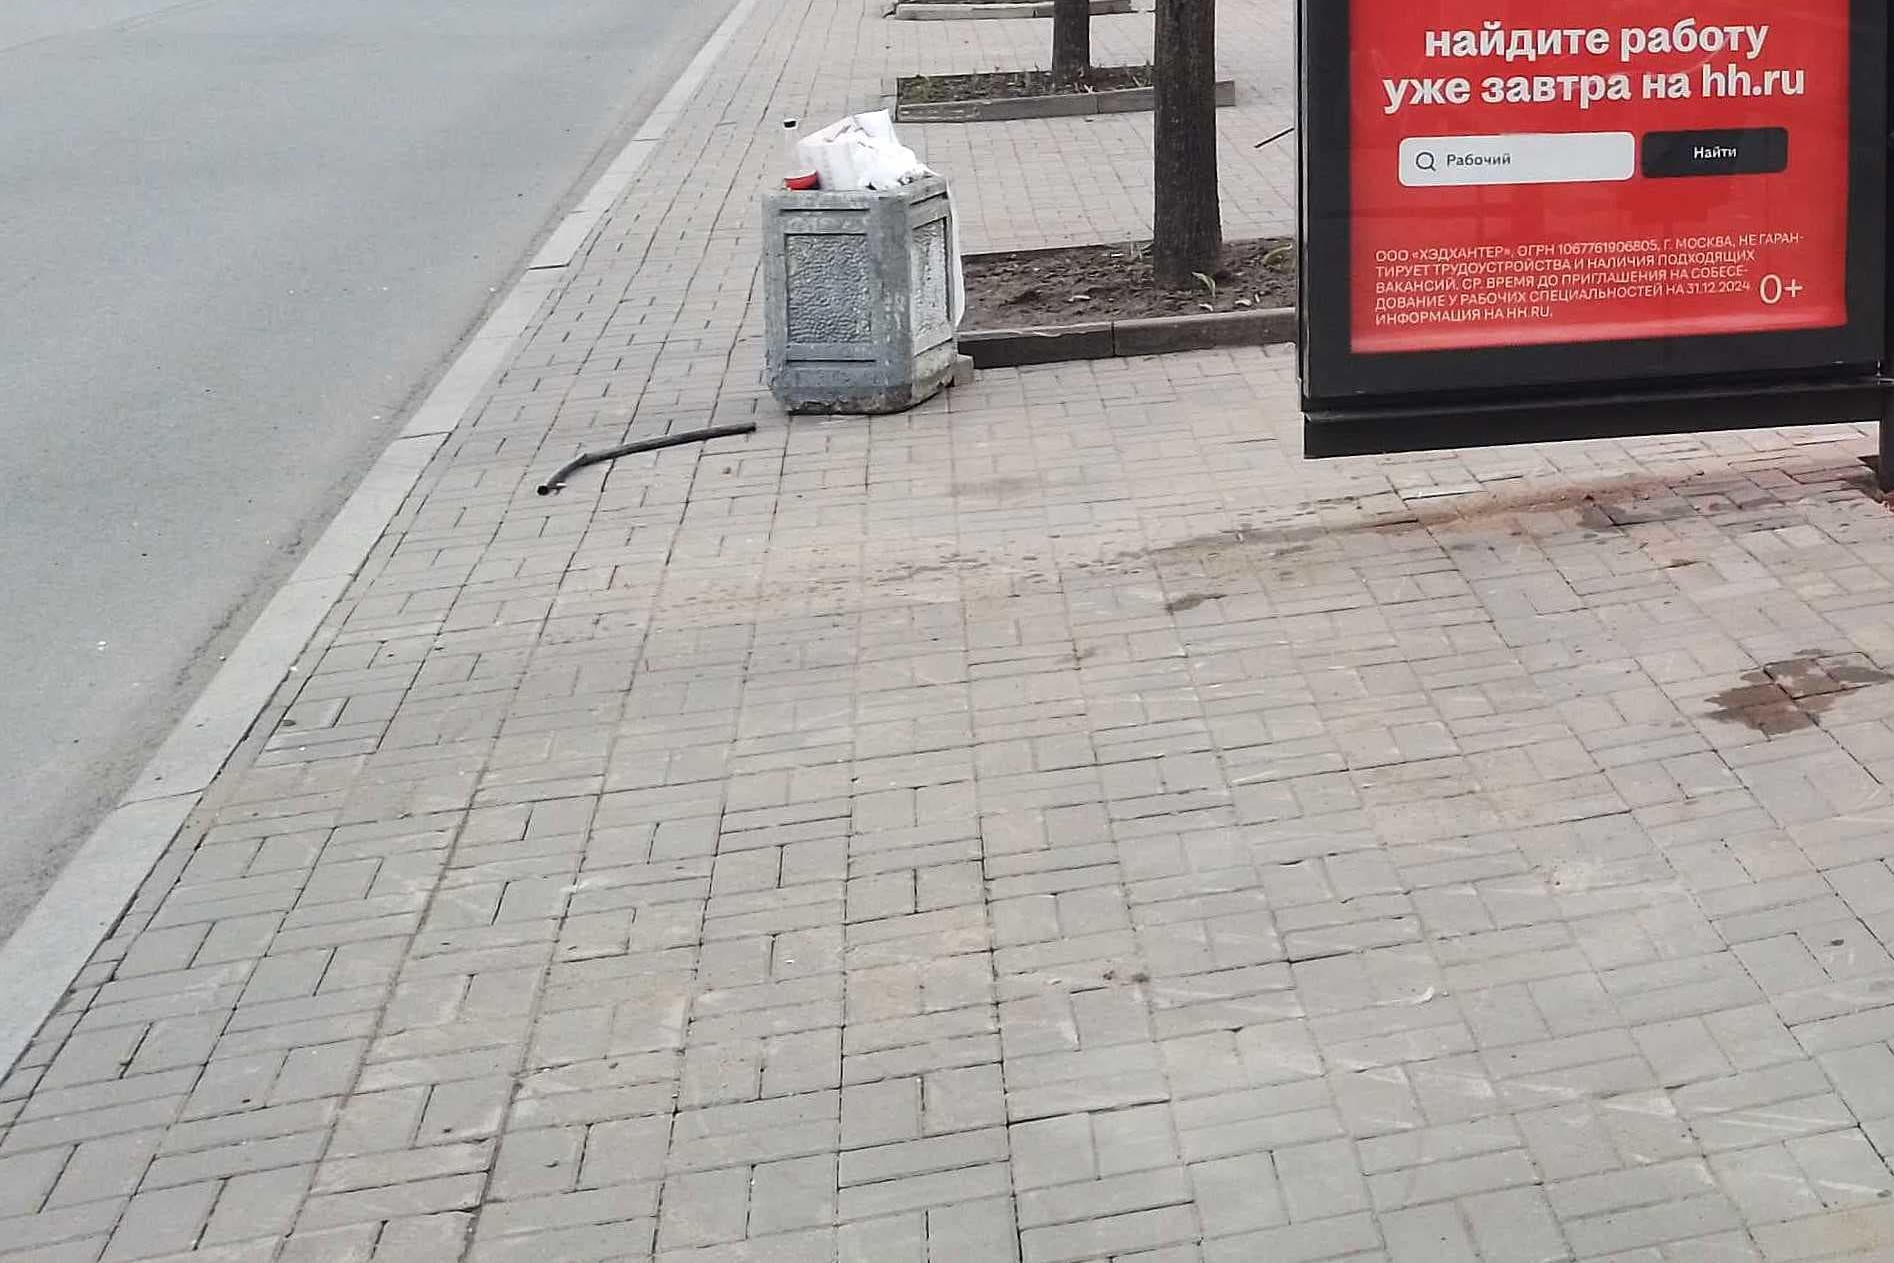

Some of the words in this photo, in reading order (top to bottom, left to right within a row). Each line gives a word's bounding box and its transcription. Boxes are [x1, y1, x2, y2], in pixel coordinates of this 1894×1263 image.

[1424, 21, 1610, 62] найдите
[1620, 18, 1769, 62] работу
[1383, 77, 1471, 115] уже
[1481, 72, 1631, 109] завтра
[1642, 72, 1692, 99] на
[1703, 64, 1805, 97] hh.ru
[1446, 152, 1511, 167] Рабочий
[1694, 146, 1737, 160] Найти
[1376, 250, 1409, 262] ООО
[1518, 244, 1555, 257] ОГРН
[1739, 234, 1759, 246] НЕ
[1760, 232, 1804, 245] ГАРАН-
[1376, 265, 1431, 278] ТИРУЕТ
[1433, 258, 1571, 276] ТРУДОУСТРОЙСТВА
[1574, 259, 1583, 270] И
[1587, 255, 1654, 269] НАЛИЧИЯ
[1658, 249, 1755, 266] ПОДХОДЯЩИХ
[1486, 275, 1534, 289] ВРЕМЯ
[1537, 275, 1558, 289] ДО
[1561, 269, 1667, 286] ПРИГЛАШЕНИЯ
[1670, 269, 1688, 280] НА
[1691, 265, 1749, 279] СОБЕСЕ-
[1376, 295, 1446, 312] ДОВАНИЕ
[1448, 294, 1458, 306] У
[1461, 291, 1526, 306] РАБОЧИХ
[1530, 284, 1662, 303] СПЕЦИАЛЬНОСТЕЙ
[1666, 284, 1685, 296] НА
[1759, 274, 1803, 304] 0+
[1376, 309, 1481, 326] ИНФОРМАЦИЯ
[1484, 308, 1503, 320] НА
